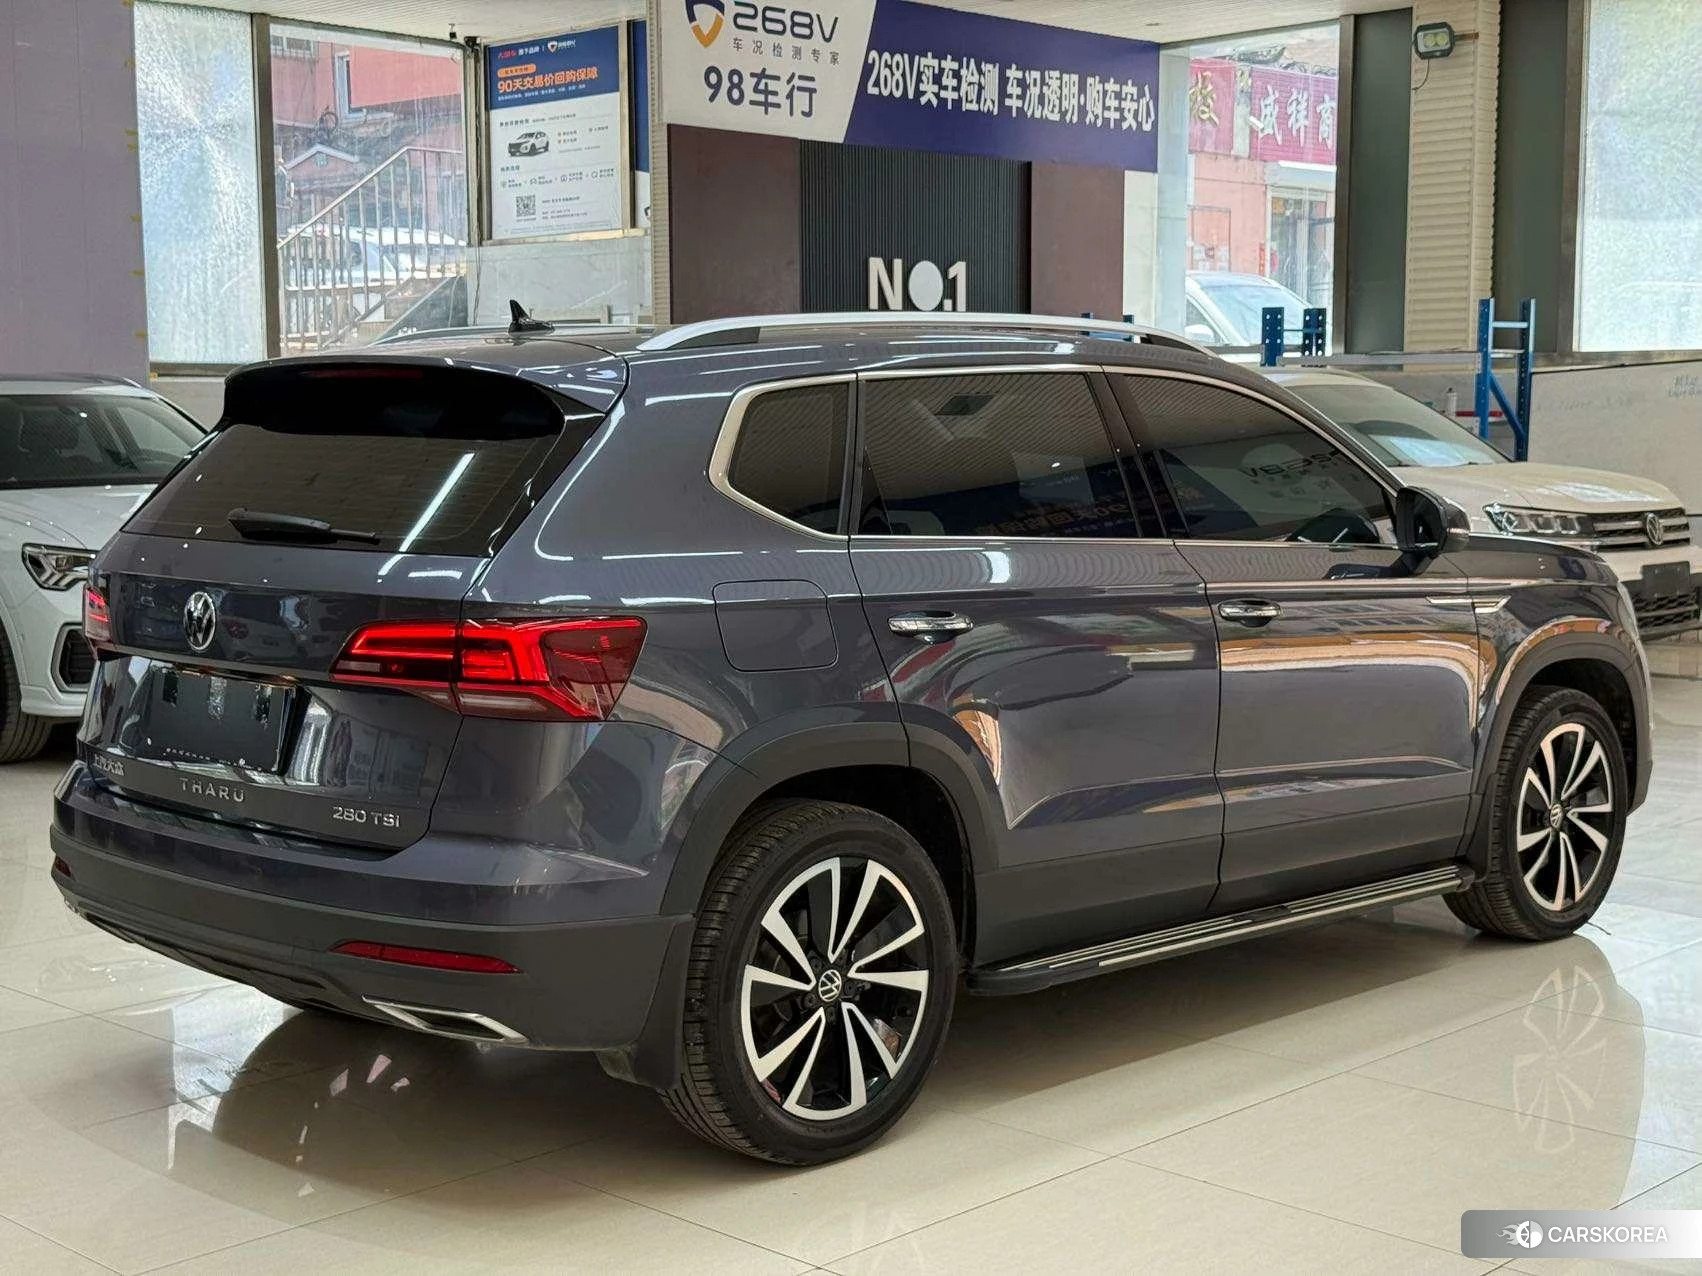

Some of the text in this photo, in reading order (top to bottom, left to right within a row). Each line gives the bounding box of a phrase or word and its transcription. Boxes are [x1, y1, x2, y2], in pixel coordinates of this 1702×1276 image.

[734, 1, 839, 43] 268V
[731, 37, 840, 66] 车况检测专家
[704, 65, 817, 118] 98车行
[867, 50, 999, 116] 268V实车检测
[179, 777, 244, 802] THARU
[332, 806, 367, 823] 280
